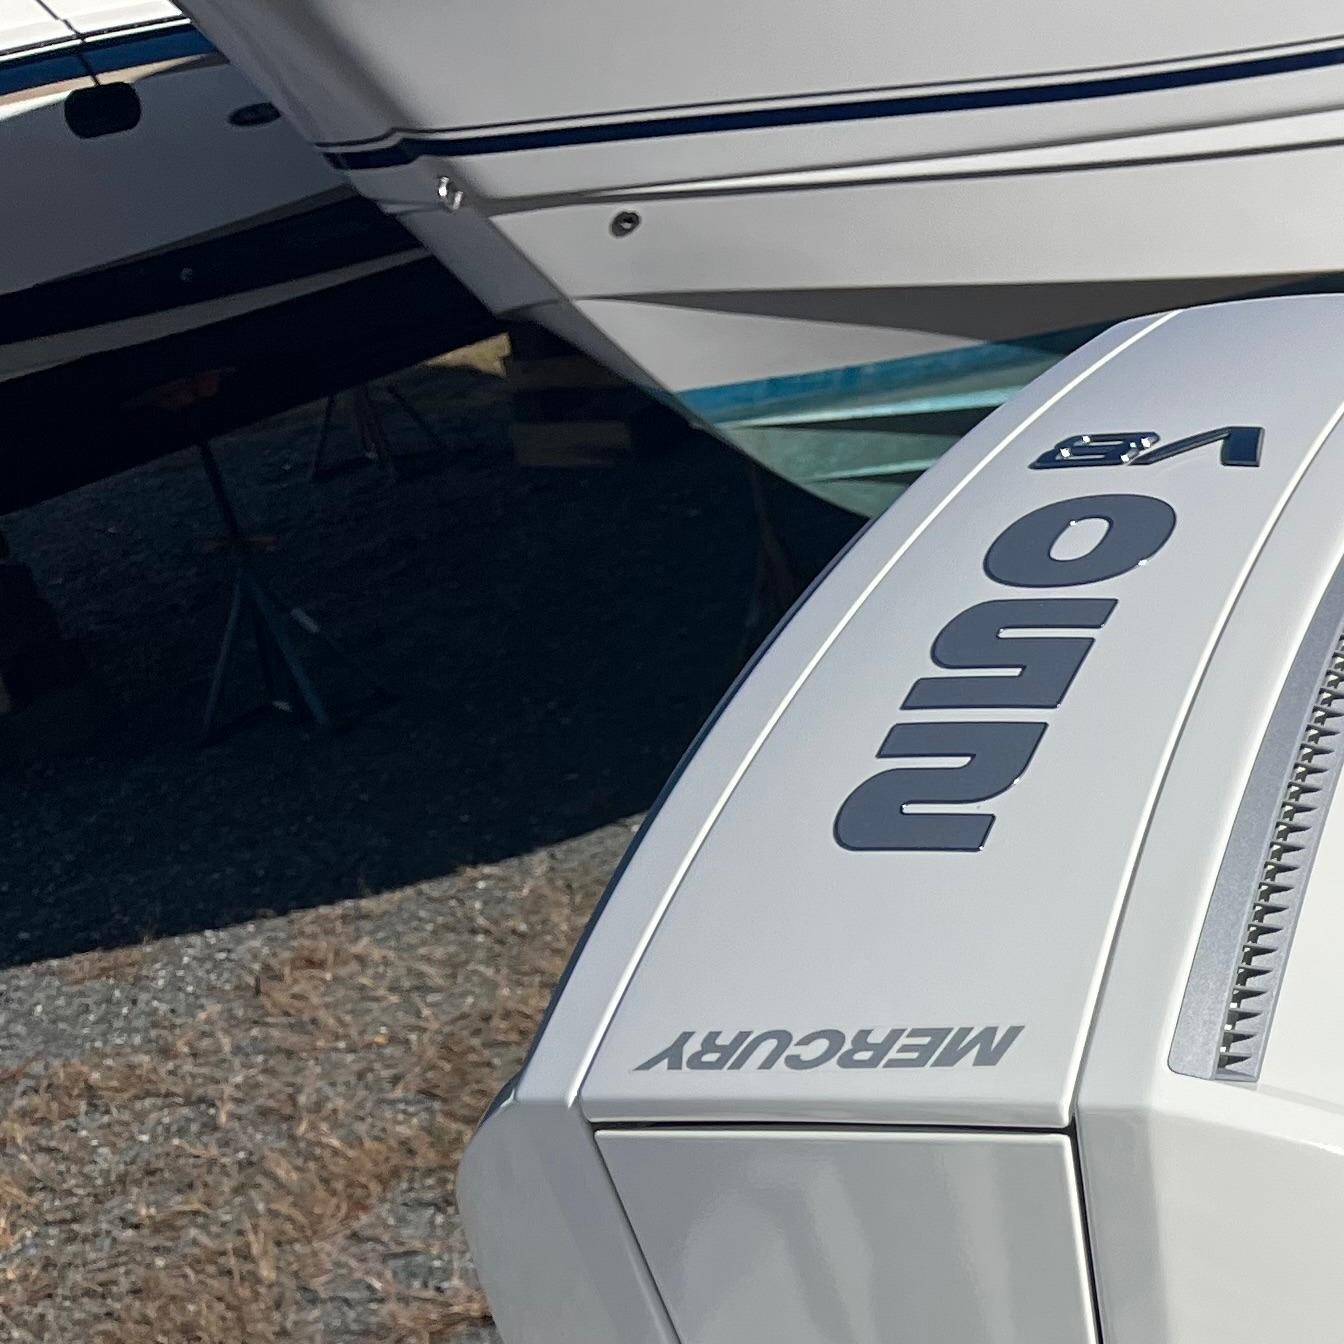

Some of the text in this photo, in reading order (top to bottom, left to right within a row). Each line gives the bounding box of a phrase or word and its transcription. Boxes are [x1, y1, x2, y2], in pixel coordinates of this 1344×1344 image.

[1026, 425, 1267, 469] V8
[832, 492, 1178, 852] 250
[634, 1023, 1024, 1071] MERCURY
